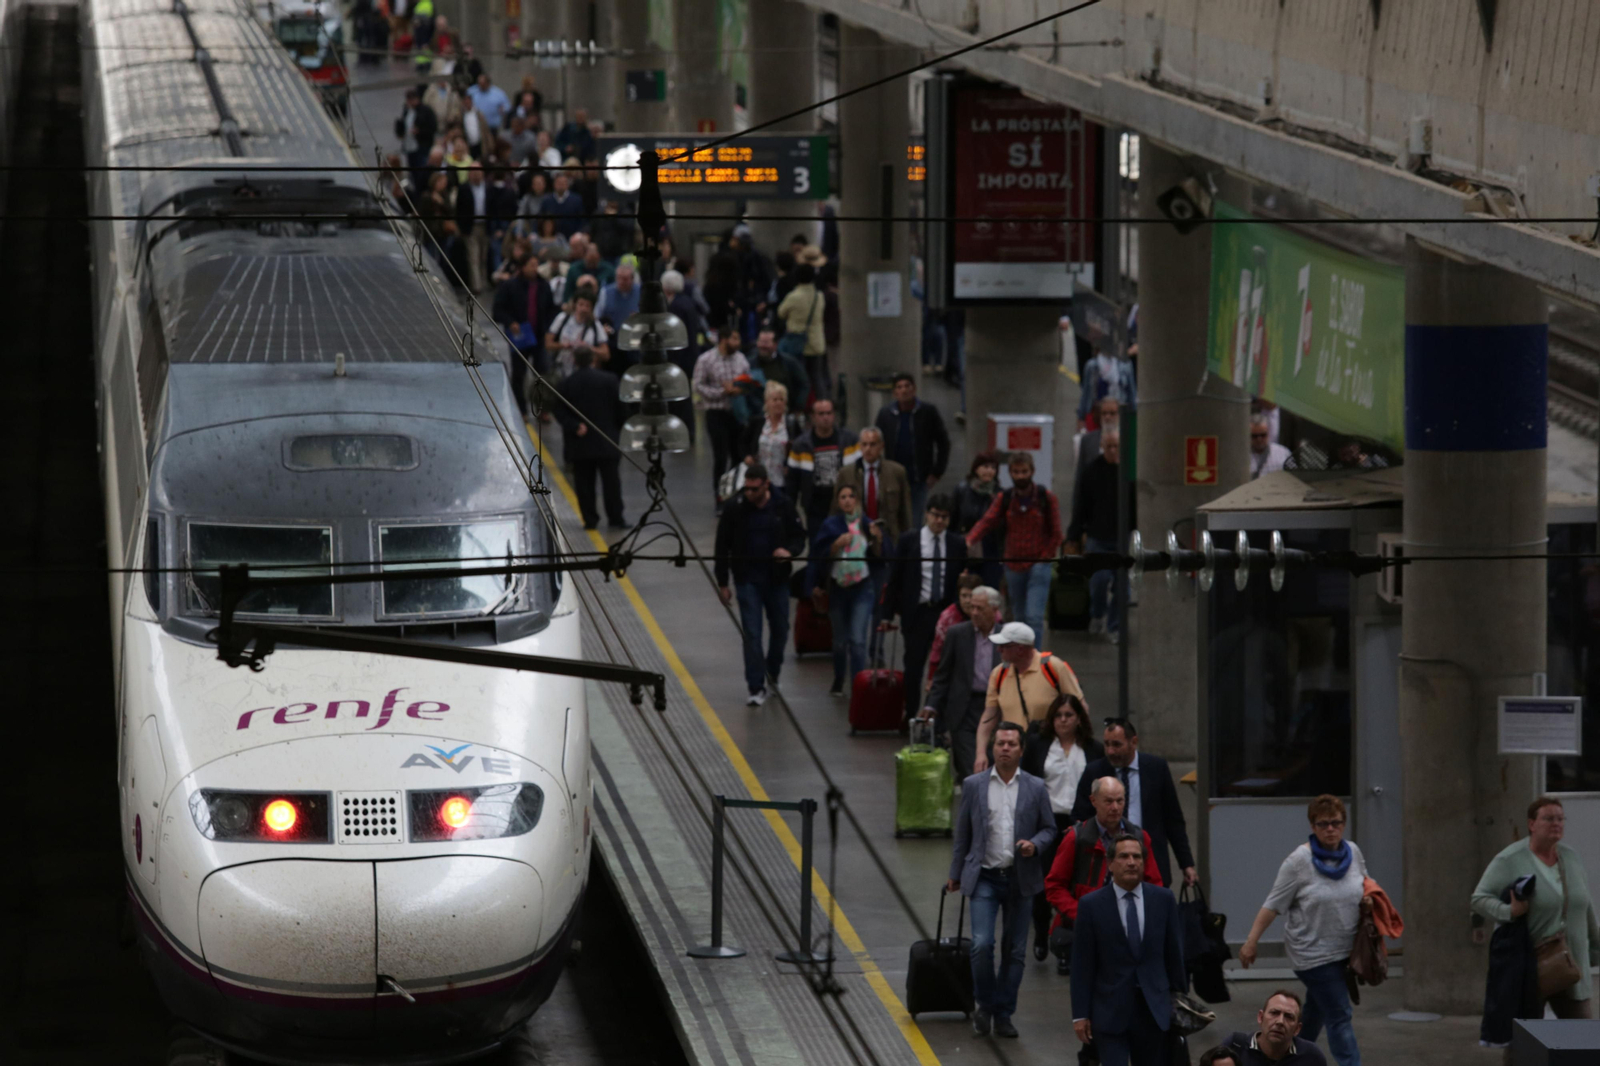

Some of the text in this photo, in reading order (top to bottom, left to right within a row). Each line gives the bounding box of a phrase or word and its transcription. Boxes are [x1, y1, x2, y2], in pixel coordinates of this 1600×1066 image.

[972, 118, 991, 132] LA
[1008, 136, 1043, 167] SÍ
[793, 166, 811, 194] 3
[977, 173, 1074, 190] IMPORTA
[236, 687, 451, 731] renfe
[400, 743, 512, 775] AVE
